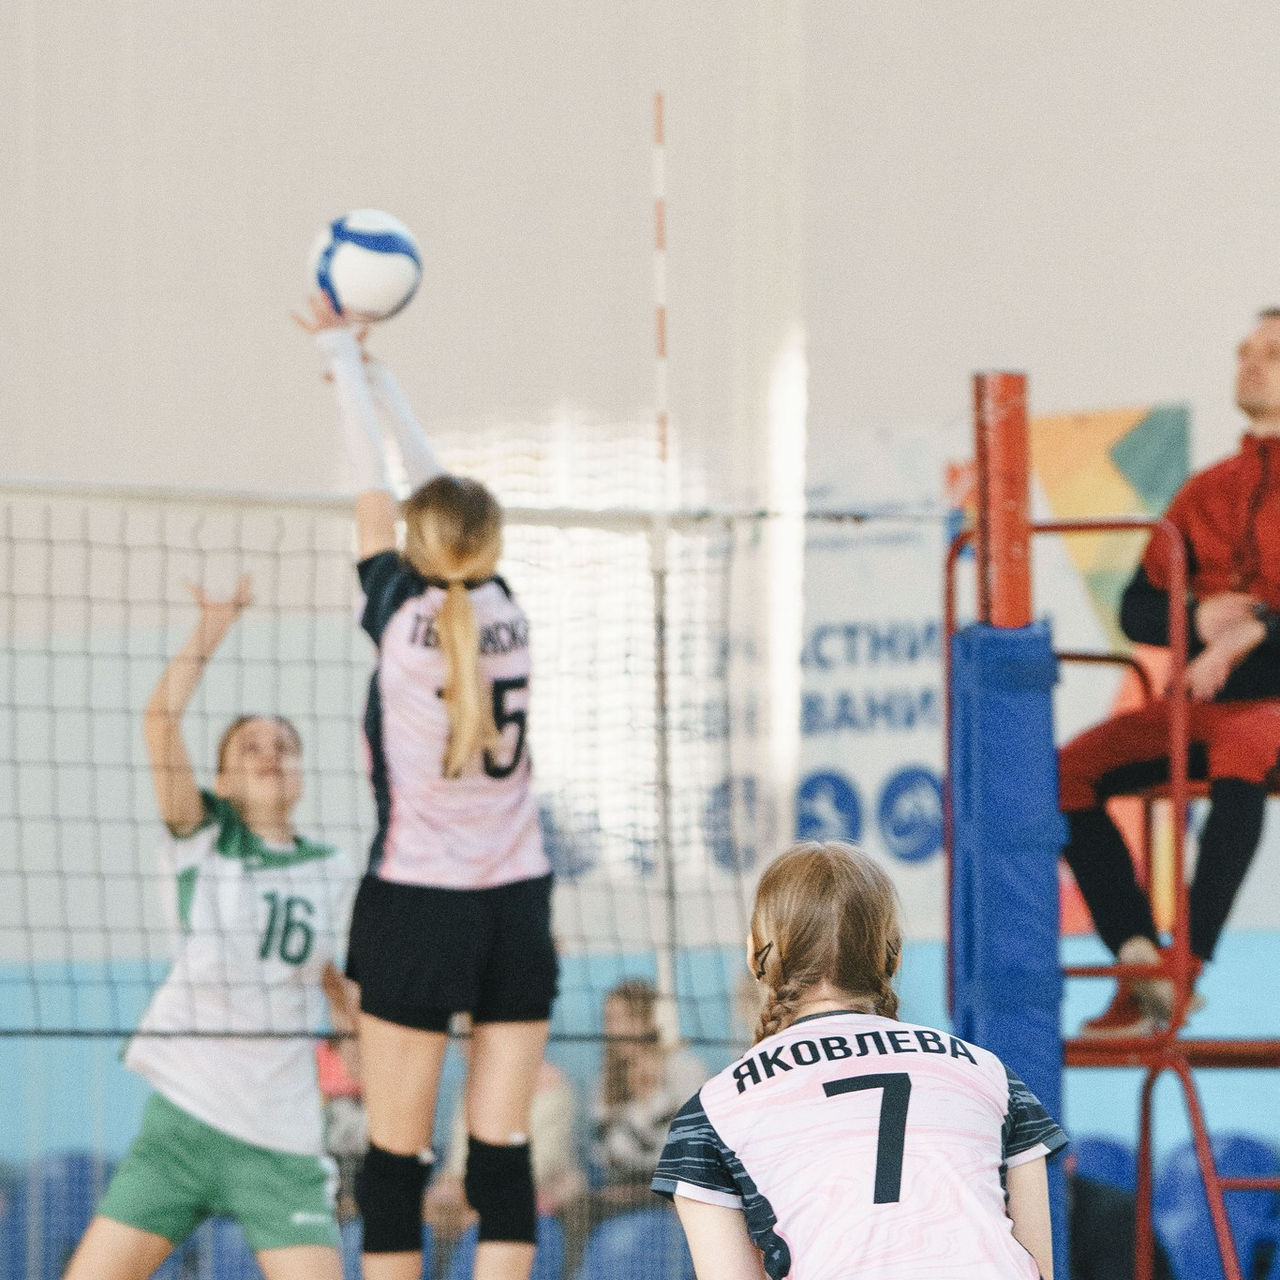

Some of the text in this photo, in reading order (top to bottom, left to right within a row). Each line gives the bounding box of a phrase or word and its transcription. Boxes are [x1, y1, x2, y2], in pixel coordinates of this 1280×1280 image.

[259, 890, 316, 967] 16
[732, 1030, 979, 1095] ЯКОВЛЕВА
[821, 1072, 913, 1205] 7
